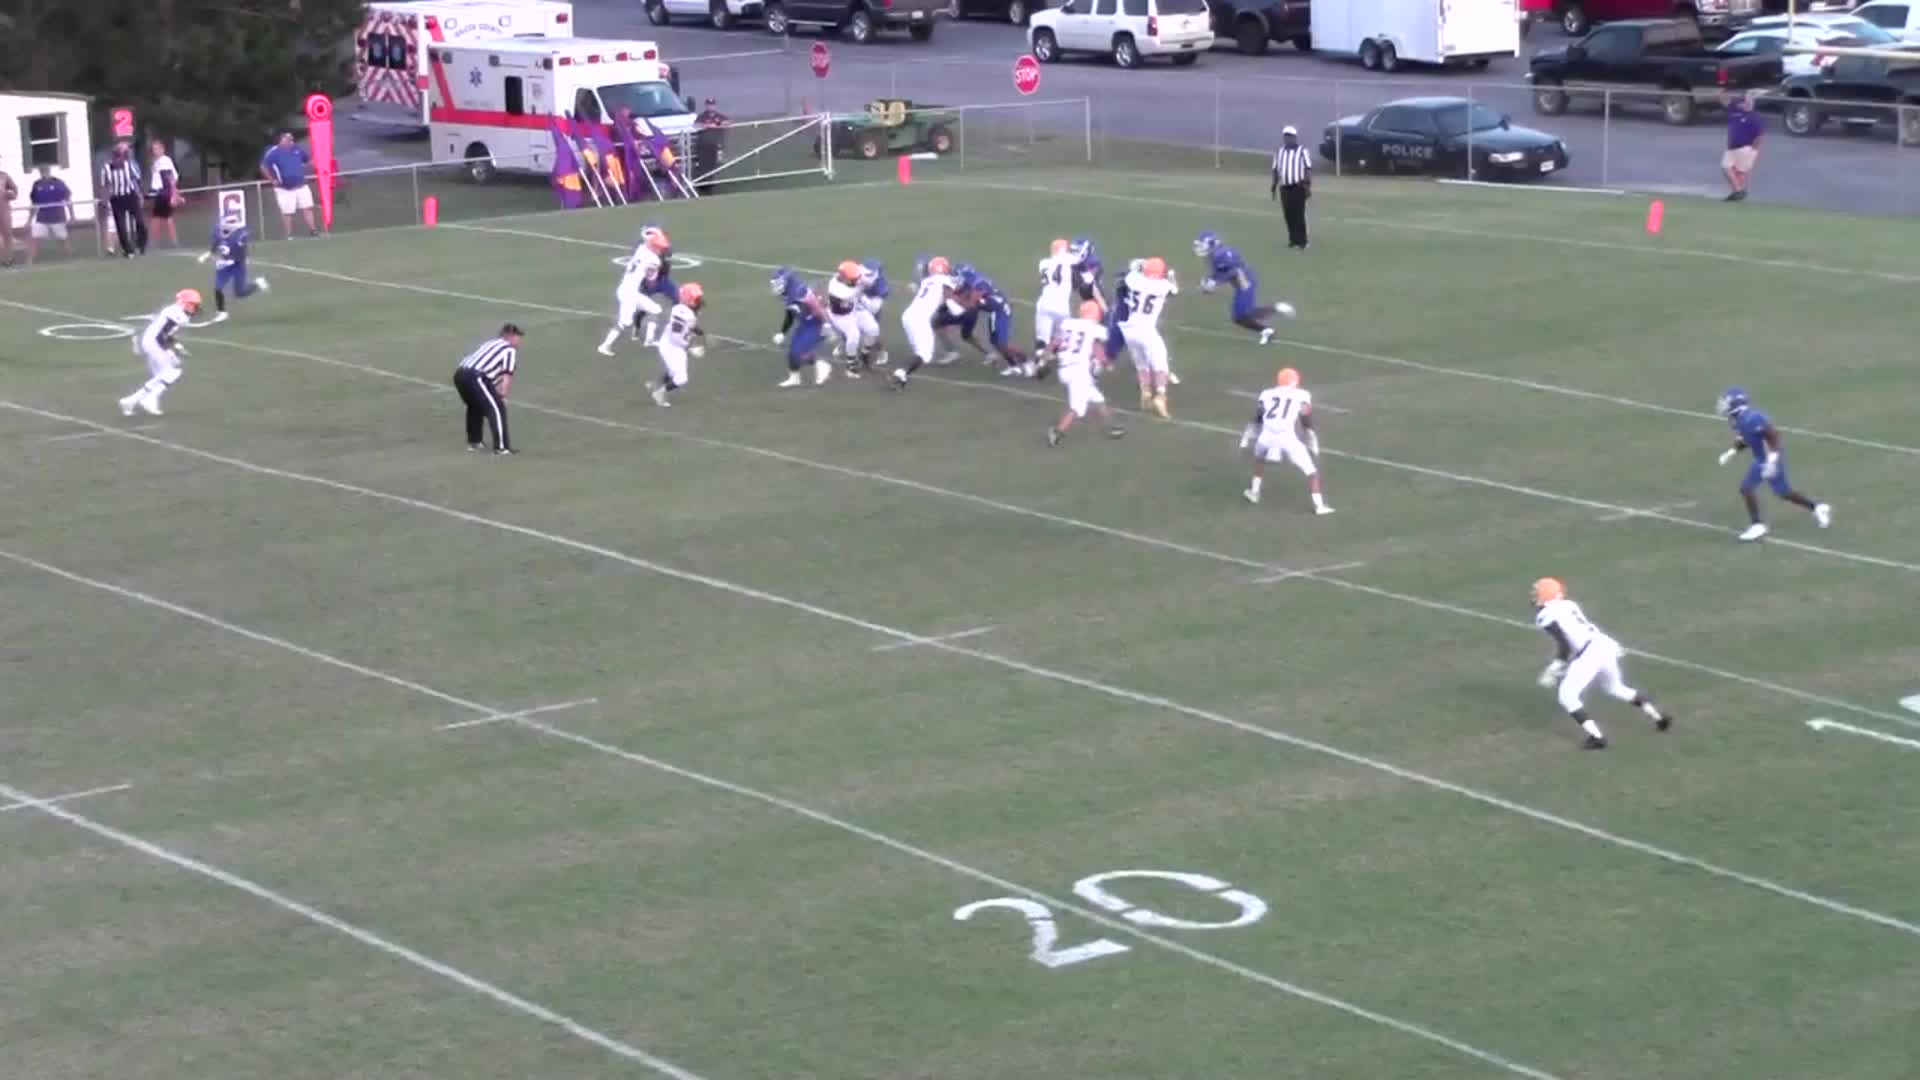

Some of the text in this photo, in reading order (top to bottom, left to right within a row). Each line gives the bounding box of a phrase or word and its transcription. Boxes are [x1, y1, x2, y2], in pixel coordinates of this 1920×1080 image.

[1015, 67, 1039, 84] STOP
[114, 108, 133, 136] 2
[1382, 143, 1433, 160] POLICE
[1040, 263, 1063, 287] 54
[1130, 290, 1157, 315] 56
[1266, 396, 1292, 419] 21
[953, 869, 1268, 968] 20
